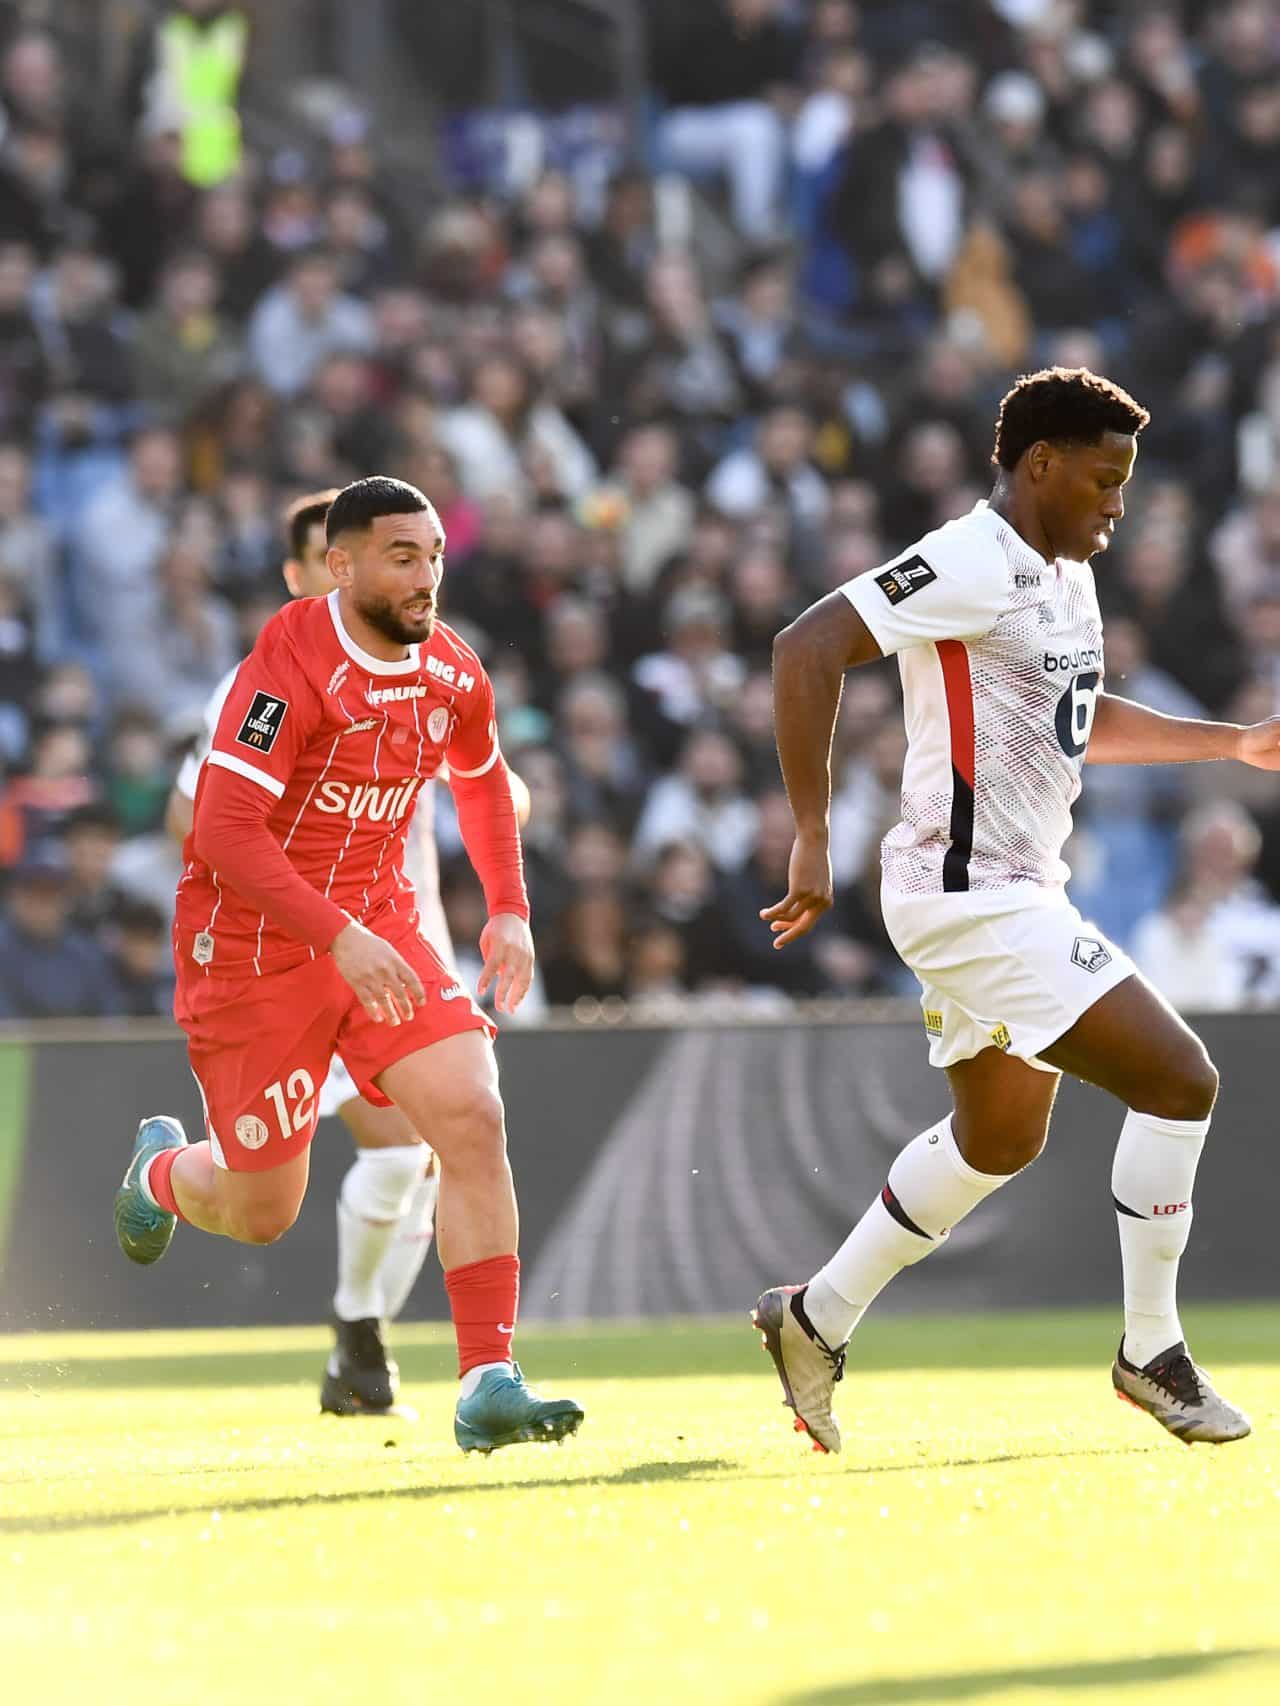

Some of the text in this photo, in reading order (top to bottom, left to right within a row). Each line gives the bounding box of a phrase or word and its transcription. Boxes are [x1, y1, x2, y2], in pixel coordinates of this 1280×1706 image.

[425, 655, 475, 692] BIG M
[371, 686, 428, 704] FAUN
[264, 1068, 314, 1140] 12
